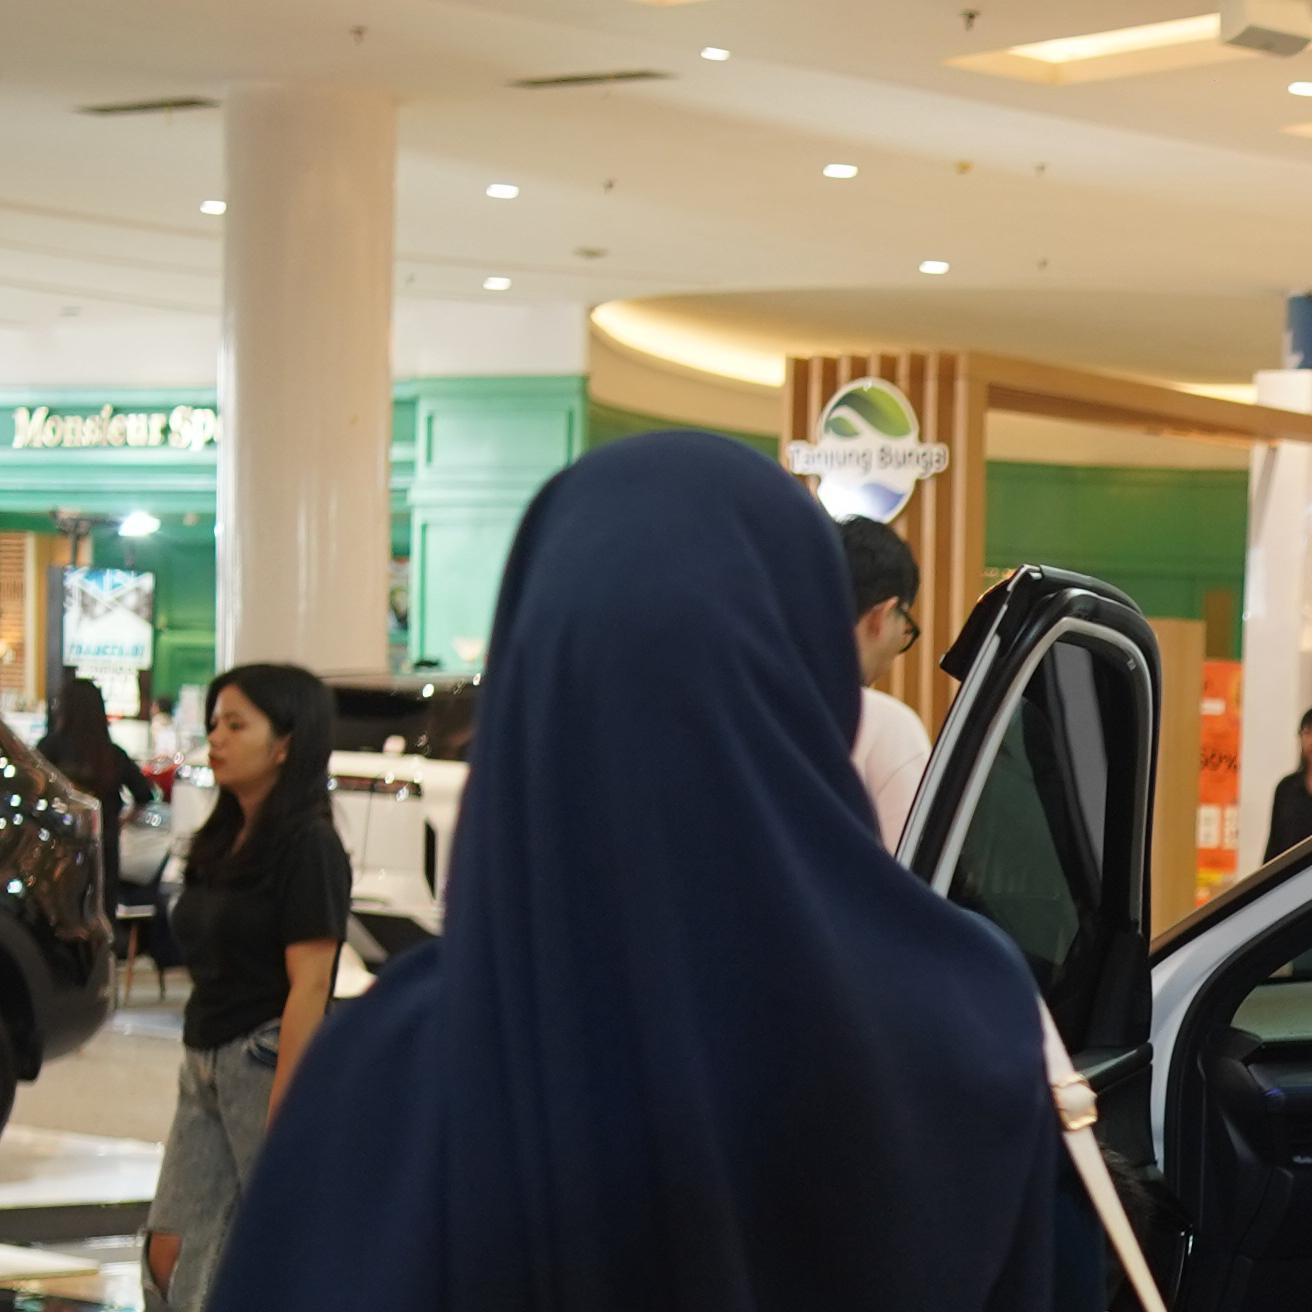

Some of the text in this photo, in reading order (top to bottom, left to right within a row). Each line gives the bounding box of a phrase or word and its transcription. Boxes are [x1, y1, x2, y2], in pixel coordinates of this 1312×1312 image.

[12, 403, 167, 449] Monsieur
[790, 446, 947, 477] Tanjung Bunga
